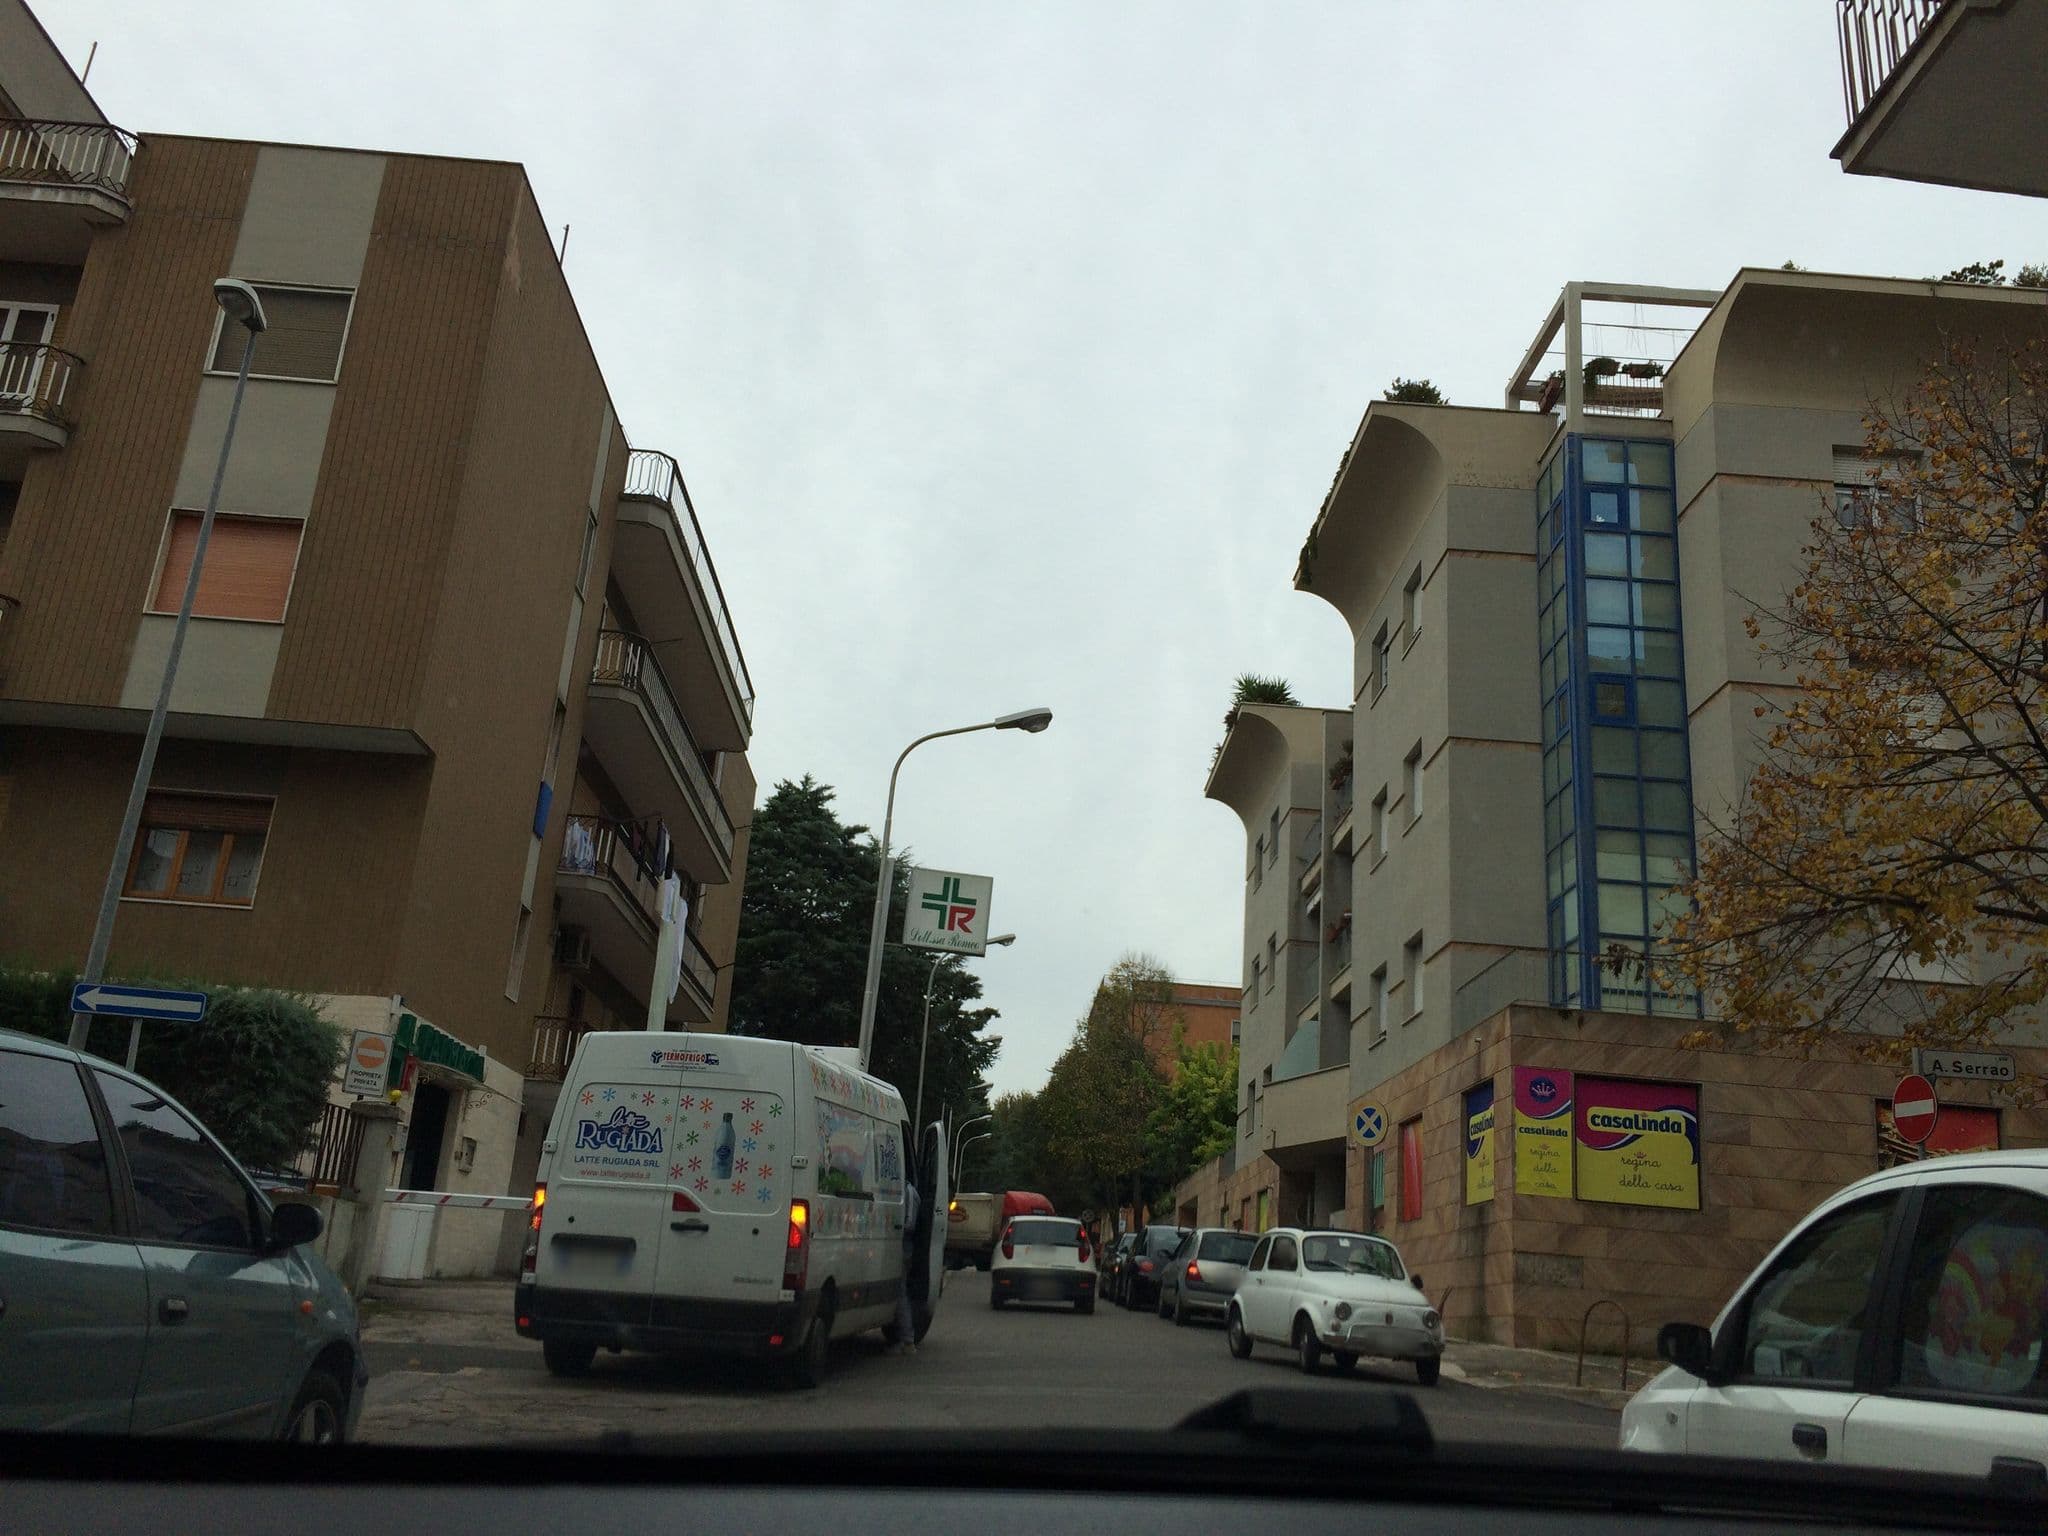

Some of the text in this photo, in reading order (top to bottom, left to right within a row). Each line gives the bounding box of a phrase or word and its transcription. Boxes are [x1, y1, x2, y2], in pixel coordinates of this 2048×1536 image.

[663, 1052, 705, 1063] TERMOFRIGO
[1932, 1059, 2009, 1077] A. Serrao
[1470, 1111, 1495, 1136] casalind
[1590, 1111, 1683, 1135] casalinda
[1518, 1125, 1569, 1138] casalinda
[1529, 1147, 1561, 1160] regina
[574, 1155, 661, 1168] LATTE RUGIADA SRL
[1532, 1162, 1560, 1174] della
[1619, 1155, 1662, 1171] regina
[1617, 1173, 1685, 1193] della casa
